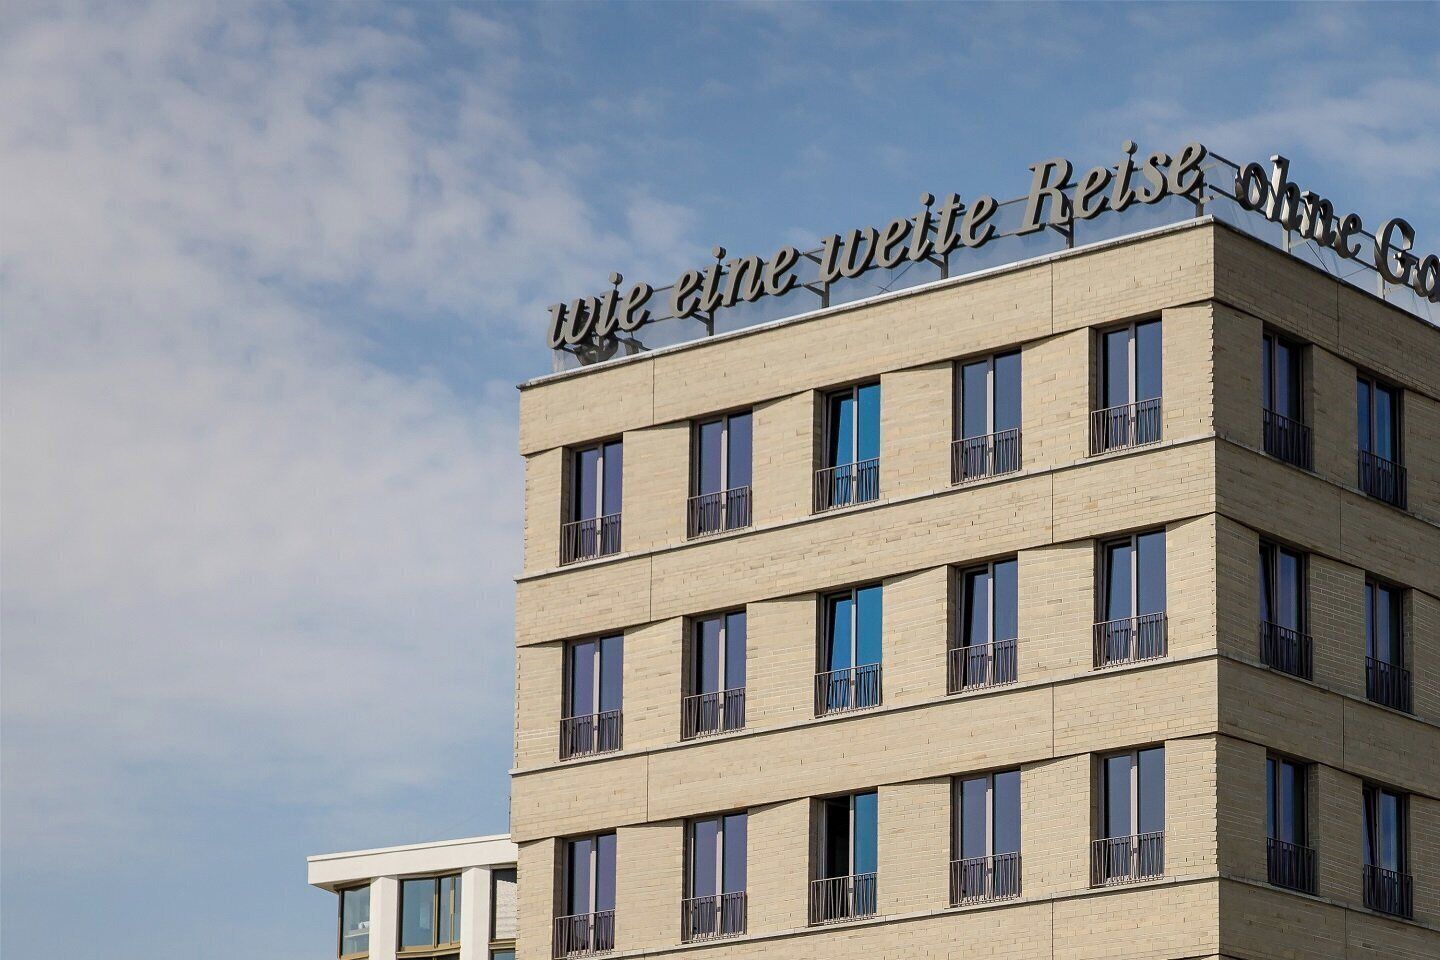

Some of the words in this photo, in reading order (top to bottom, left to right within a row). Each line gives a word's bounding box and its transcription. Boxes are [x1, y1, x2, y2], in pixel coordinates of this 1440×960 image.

[547, 272, 653, 351] wie
[668, 246, 800, 320] eine
[818, 192, 999, 283] weite
[1013, 139, 1209, 236] Reise
[1235, 153, 1363, 259] ohne
